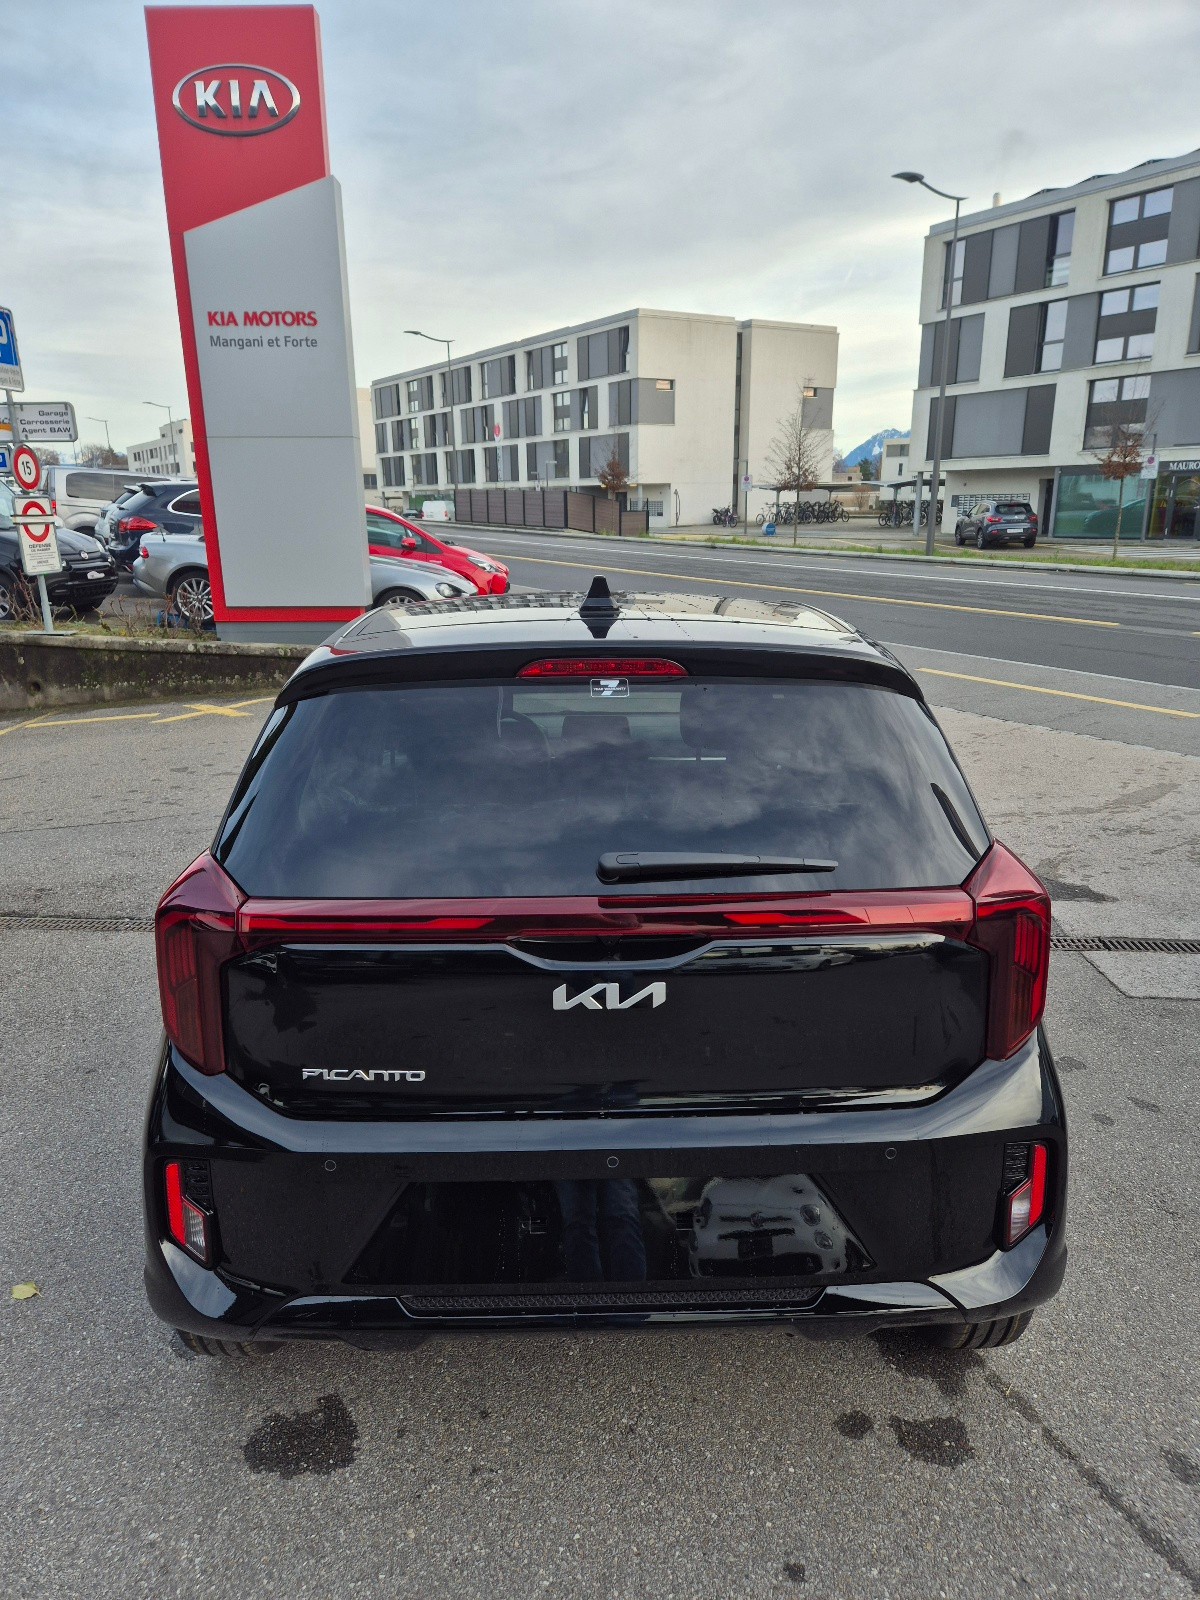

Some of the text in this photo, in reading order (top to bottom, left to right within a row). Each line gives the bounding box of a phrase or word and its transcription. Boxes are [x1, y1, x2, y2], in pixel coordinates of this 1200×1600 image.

[194, 79, 279, 118] KIA
[207, 310, 318, 327] KIA MOTORS
[209, 335, 318, 350] Mangani et Forte
[21, 461, 32, 476] 15
[552, 981, 667, 1011] KIA
[302, 1068, 426, 1082] PICANTO
